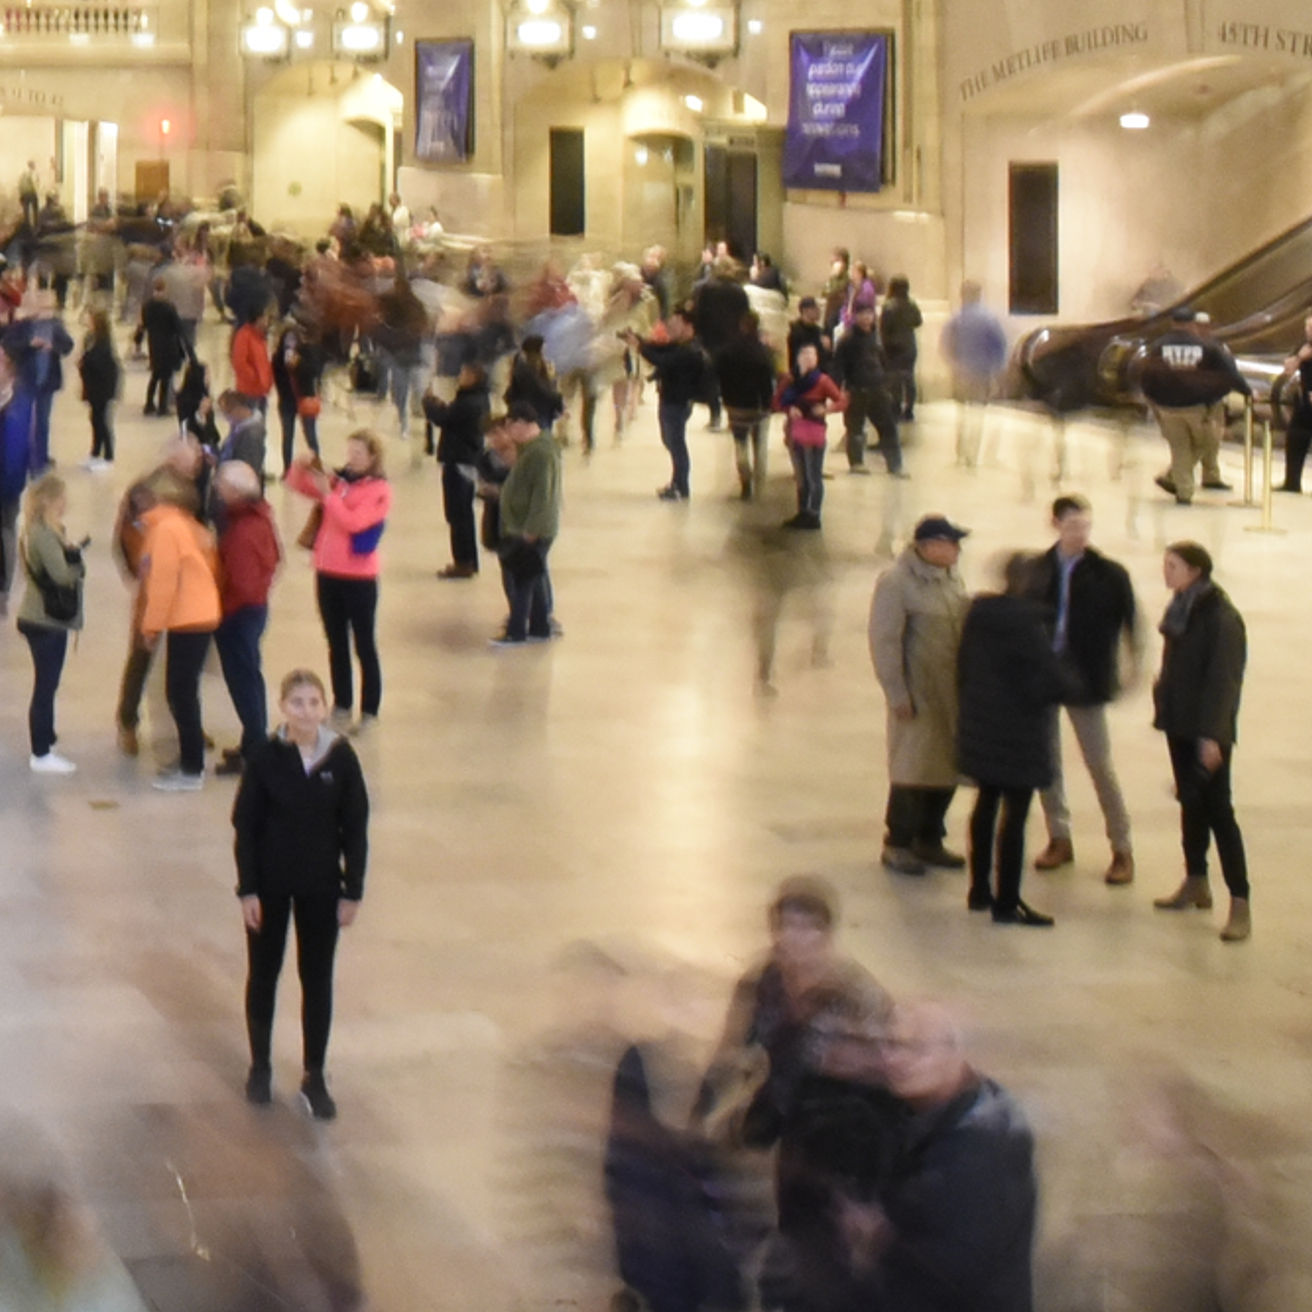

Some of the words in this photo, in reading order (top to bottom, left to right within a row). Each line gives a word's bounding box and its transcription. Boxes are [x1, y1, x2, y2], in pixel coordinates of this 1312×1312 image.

[960, 70, 988, 101] THE
[991, 39, 1060, 82] METLIFE
[1064, 21, 1148, 56] BUILDING
